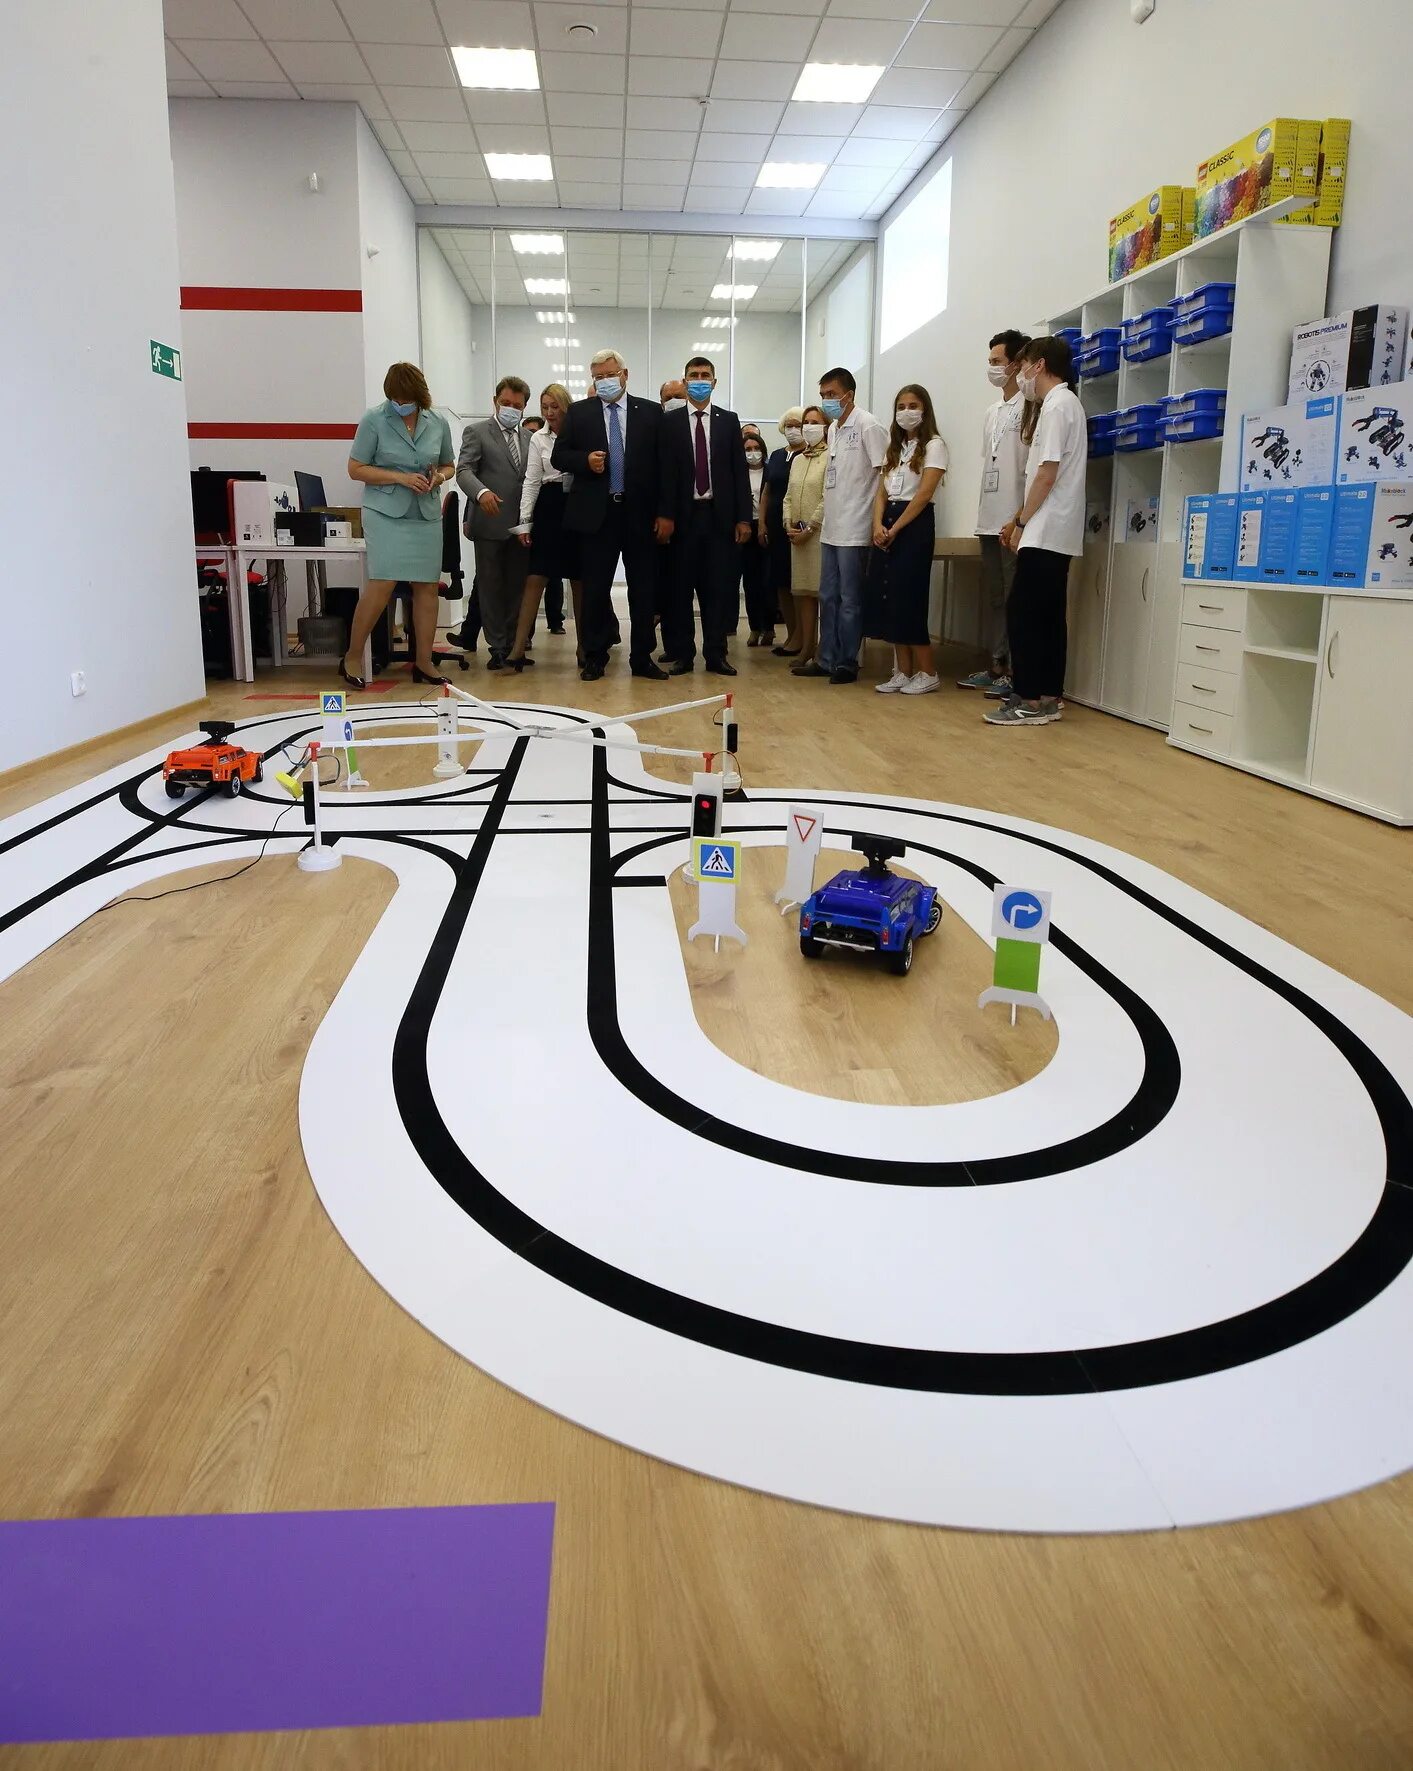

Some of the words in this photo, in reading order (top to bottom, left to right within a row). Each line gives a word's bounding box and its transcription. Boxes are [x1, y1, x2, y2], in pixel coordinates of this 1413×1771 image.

[1208, 150, 1235, 172] CLASSIC
[1297, 329, 1320, 341] ROBOTIS
[1320, 322, 1348, 335] PREMIUM
